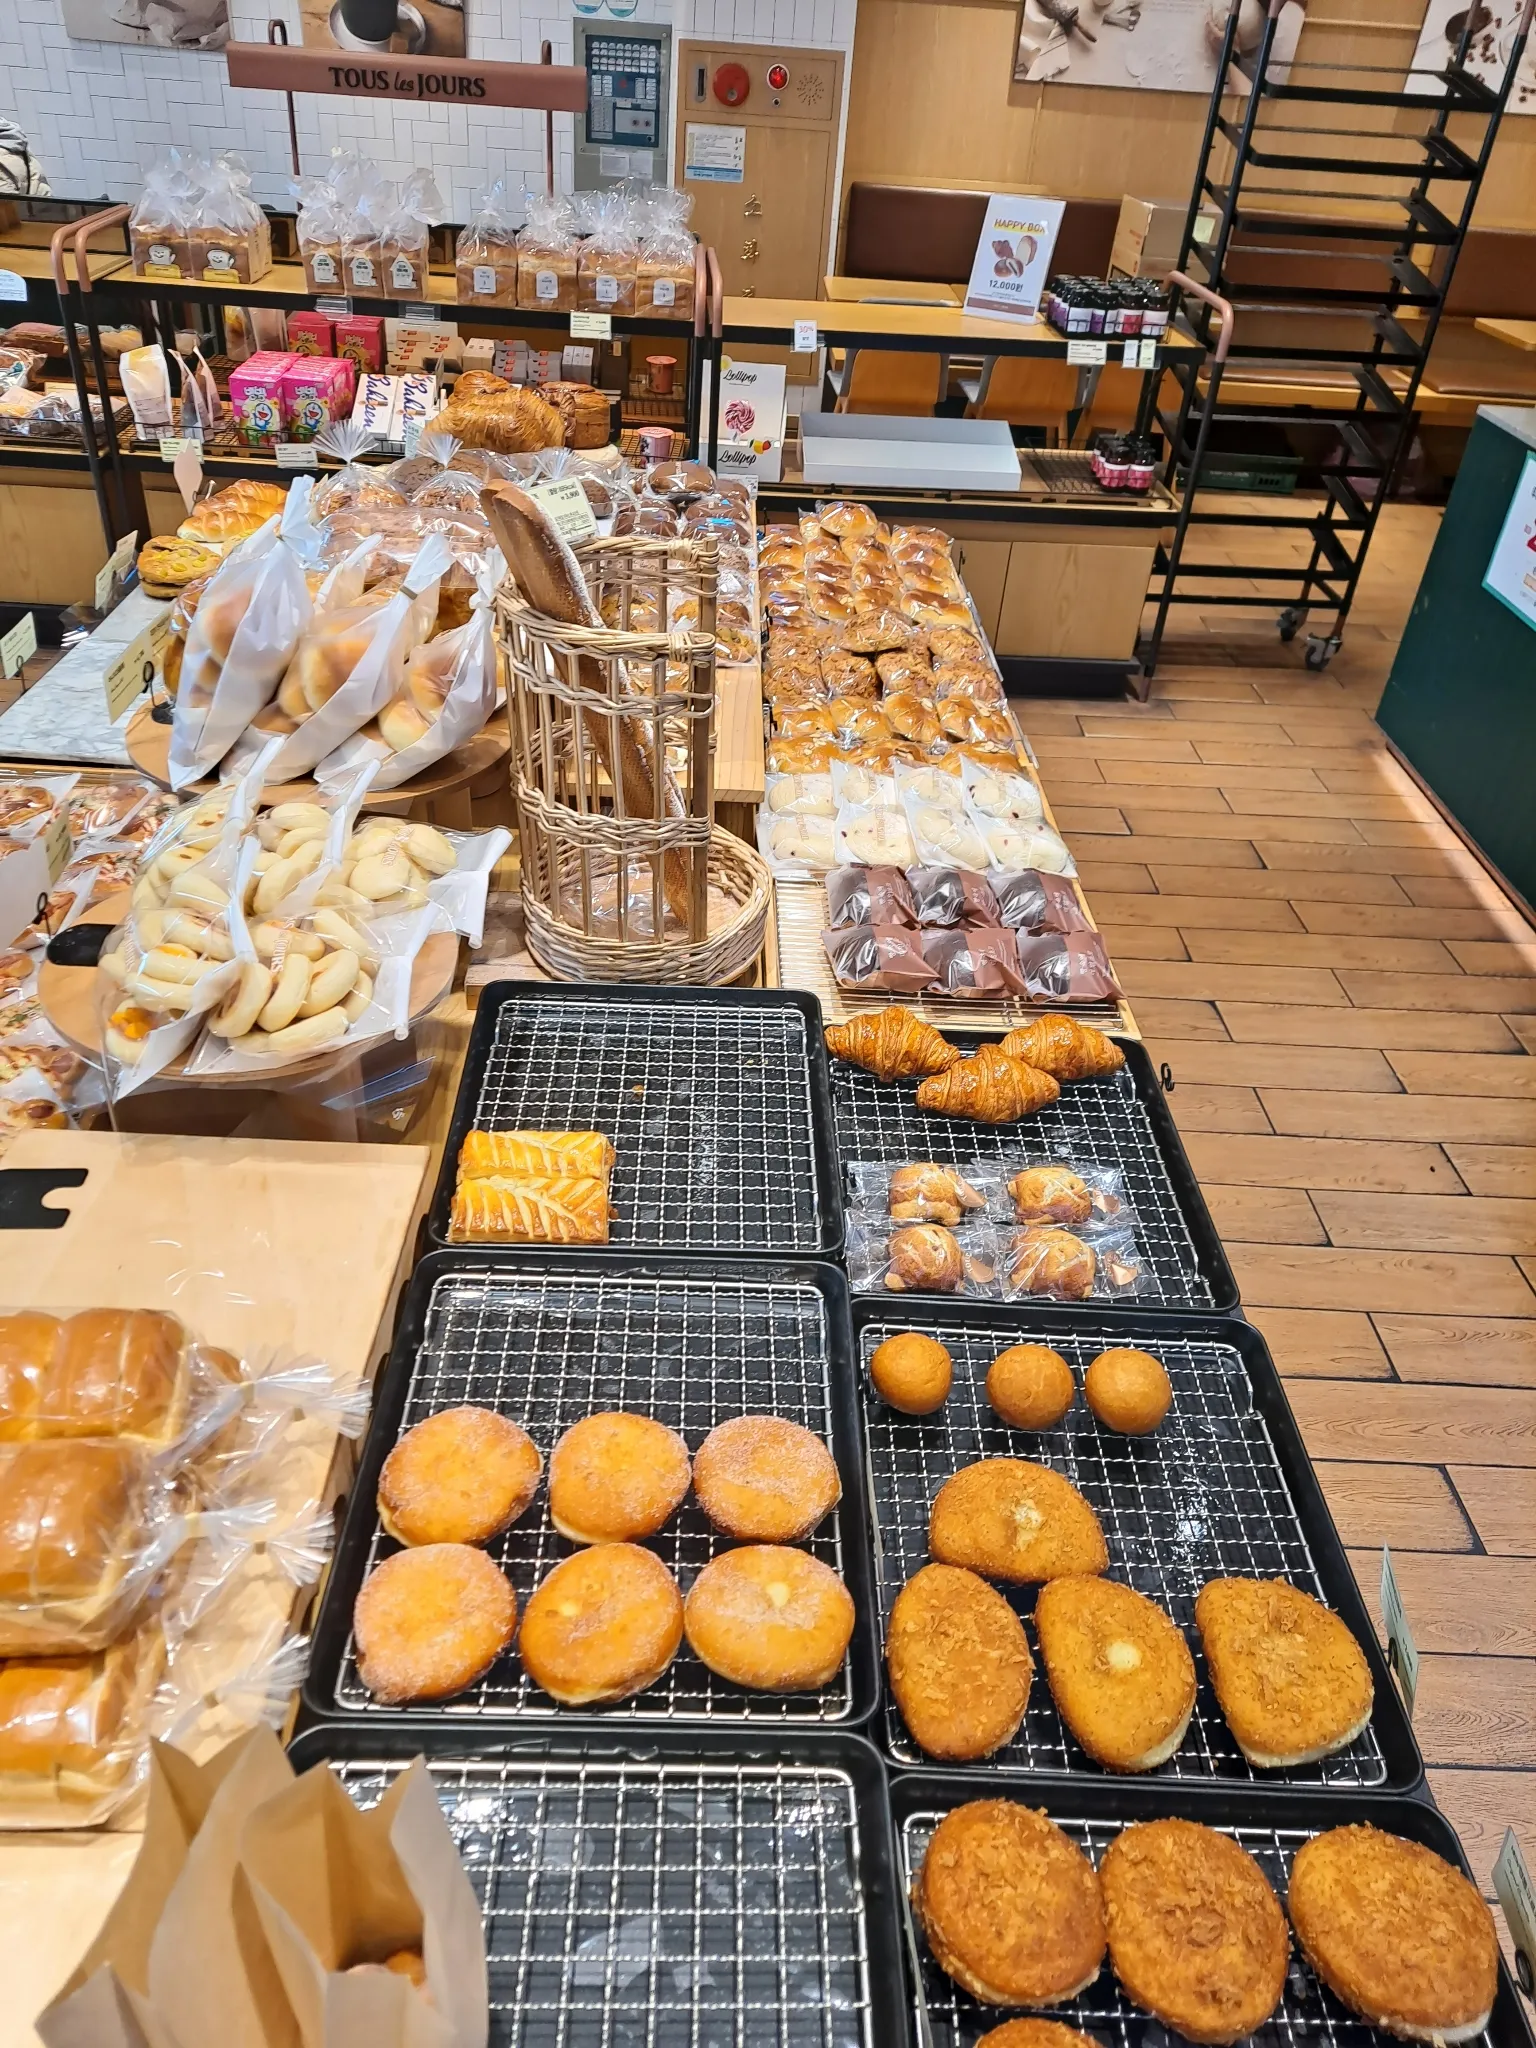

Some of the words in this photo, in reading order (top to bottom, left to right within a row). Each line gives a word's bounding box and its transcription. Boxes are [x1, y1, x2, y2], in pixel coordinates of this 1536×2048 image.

[328, 66, 389, 90] TOUS
[394, 71, 414, 92] les
[417, 73, 487, 98] JOURS
[994, 218, 1027, 231] HAPPY
[723, 369, 758, 384] Lollipop
[362, 373, 391, 428] Bahlsen
[718, 449, 757, 466] Lollipop
